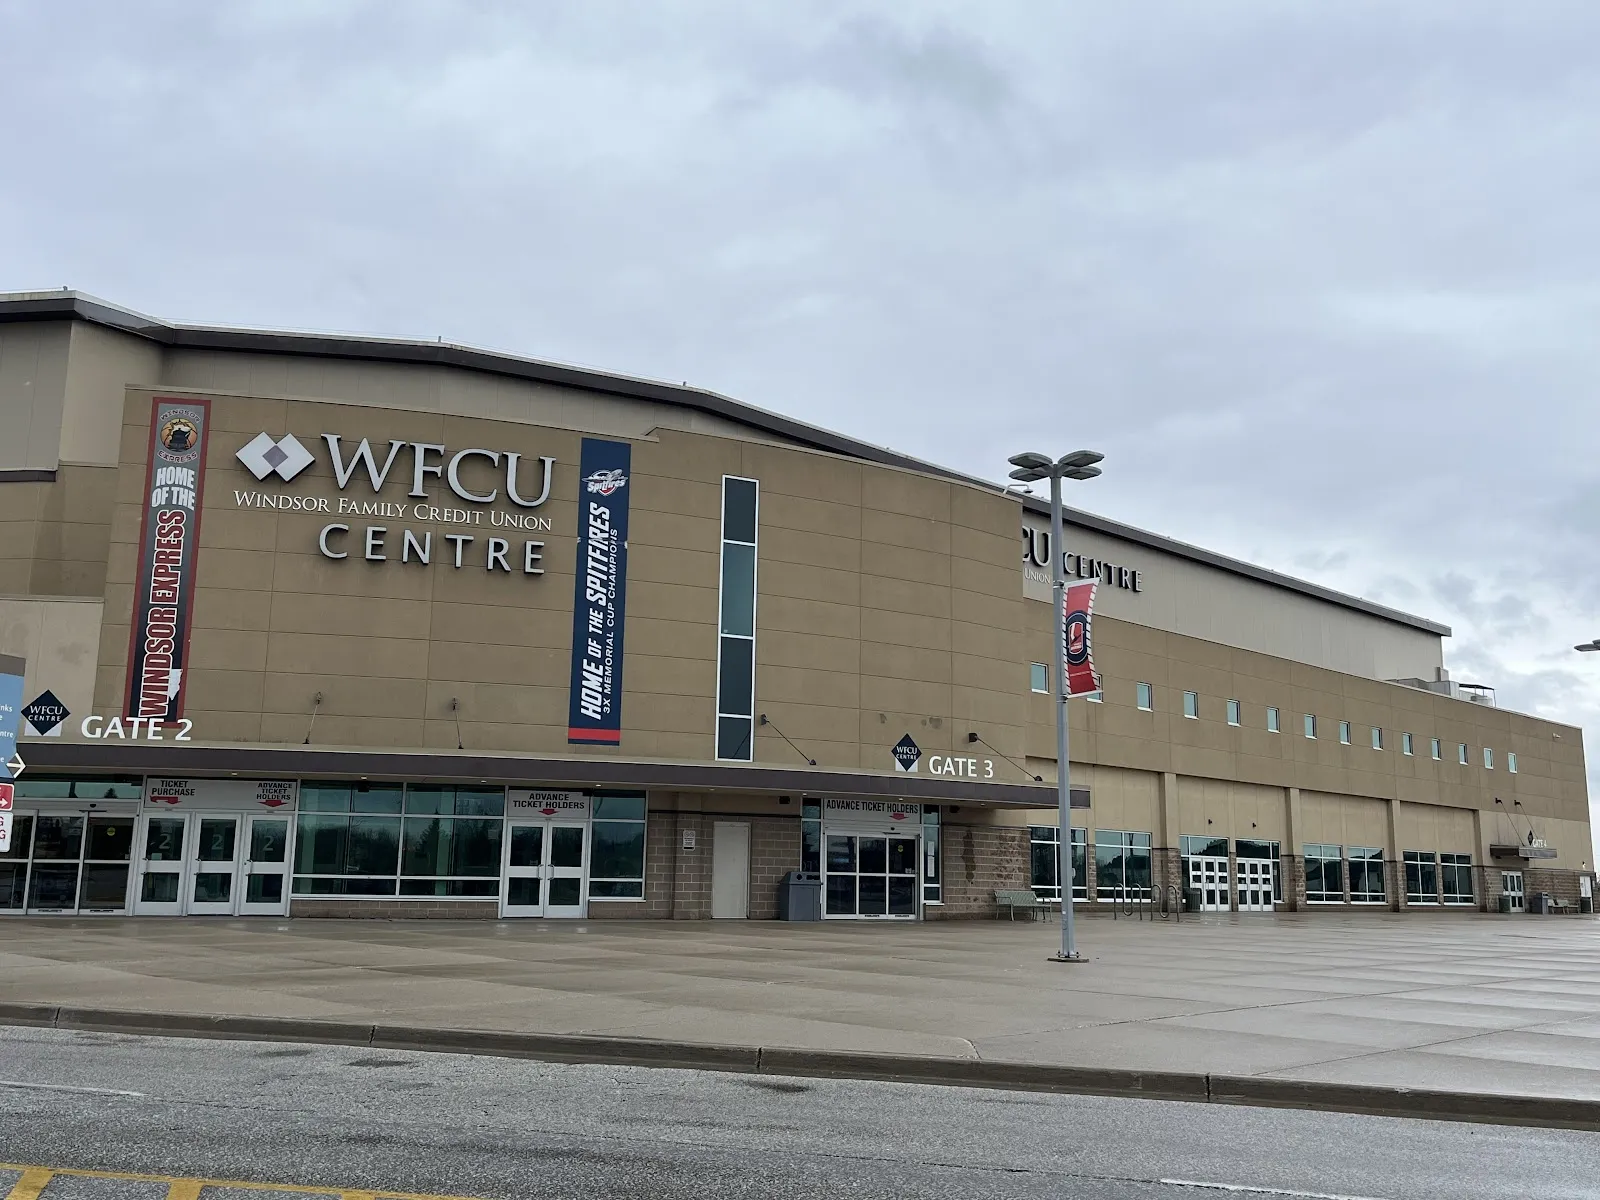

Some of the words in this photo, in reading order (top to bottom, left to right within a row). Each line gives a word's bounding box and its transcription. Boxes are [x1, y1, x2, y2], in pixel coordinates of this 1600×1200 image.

[157, 450, 198, 463] EXPRESS
[155, 466, 195, 489] HOME
[320, 433, 557, 507] WFCU
[152, 486, 169, 508] OF
[171, 487, 196, 511] THE
[234, 490, 330, 513] WINDSOR
[337, 497, 408, 518] FAMILY
[414, 503, 484, 525] CREDIT
[490, 511, 552, 531] UNION
[149, 509, 186, 605] EXPRESS
[319, 523, 545, 575] CENTRE
[585, 502, 610, 606] SPITFIRES
[608, 529, 618, 599] CHAMPIONS
[1063, 552, 1143, 592] CENTRE
[1024, 568, 1050, 584] UNION
[588, 608, 604, 634] THE
[606, 603, 615, 627] CUP
[588, 638, 602, 658] OF
[138, 607, 178, 717] WINDSOR
[604, 631, 614, 694] MEMORIAL
[580, 659, 603, 720] HOME
[0, 703, 13, 713] nks
[29, 705, 64, 715] WFCU
[603, 698, 611, 714] 3X
[0, 730, 14, 738] ntre
[81, 715, 164, 741] GATE
[175, 718, 193, 741] 2
[896, 745, 918, 754] WFCU
[929, 756, 977, 777] GATE
[983, 760, 994, 778] 3
[151, 788, 195, 796] PURCHASE
[160, 780, 188, 788] TICKET
[513, 800, 543, 808] TICKET
[545, 801, 585, 809] HOLDERS
[529, 793, 569, 801] ADVANCE
[826, 800, 860, 810] ADVANCE
[861, 801, 886, 812] TICKET
[886, 803, 918, 814] HOLDERS
[159, 834, 171, 849] 2
[212, 834, 224, 850] 2
[263, 836, 275, 851] 2
